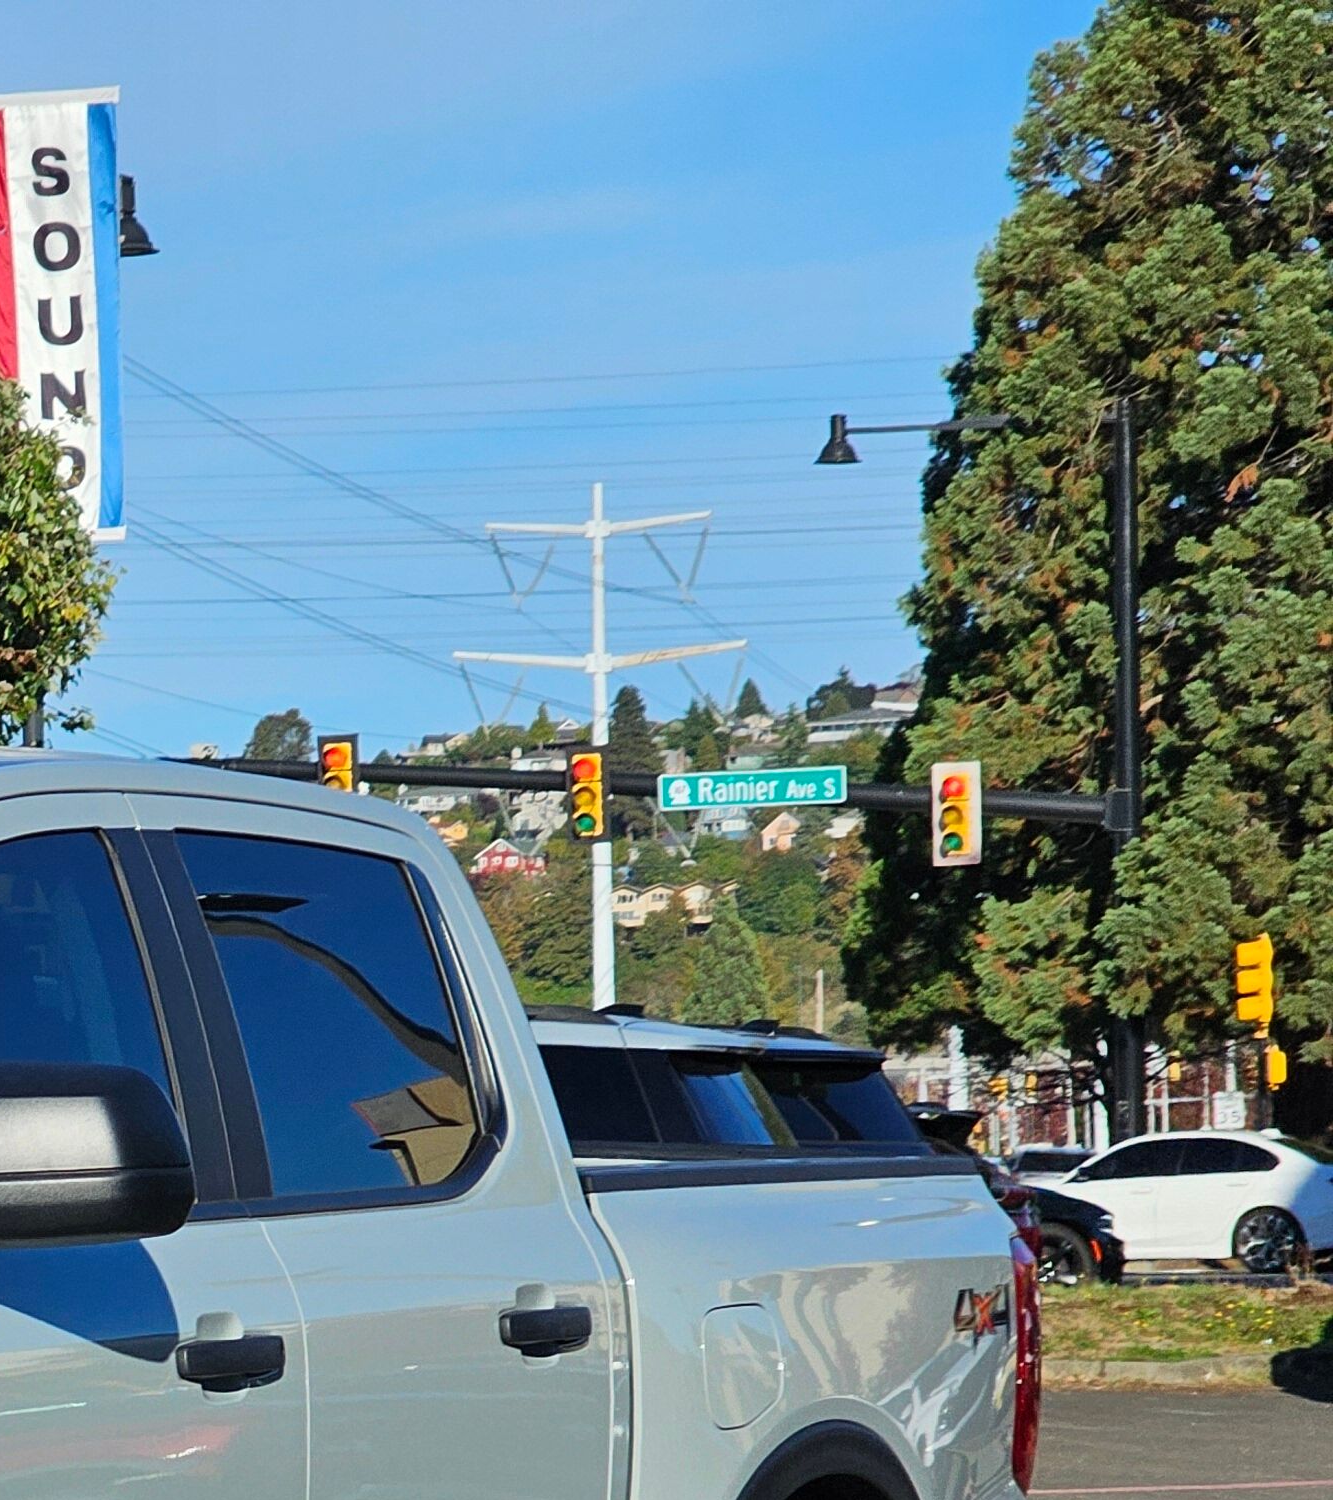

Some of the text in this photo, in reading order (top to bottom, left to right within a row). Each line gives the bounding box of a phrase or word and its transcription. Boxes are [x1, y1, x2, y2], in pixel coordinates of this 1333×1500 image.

[697, 776, 779, 804] Rainier
[785, 779, 817, 800] Ave
[823, 777, 836, 798] S
